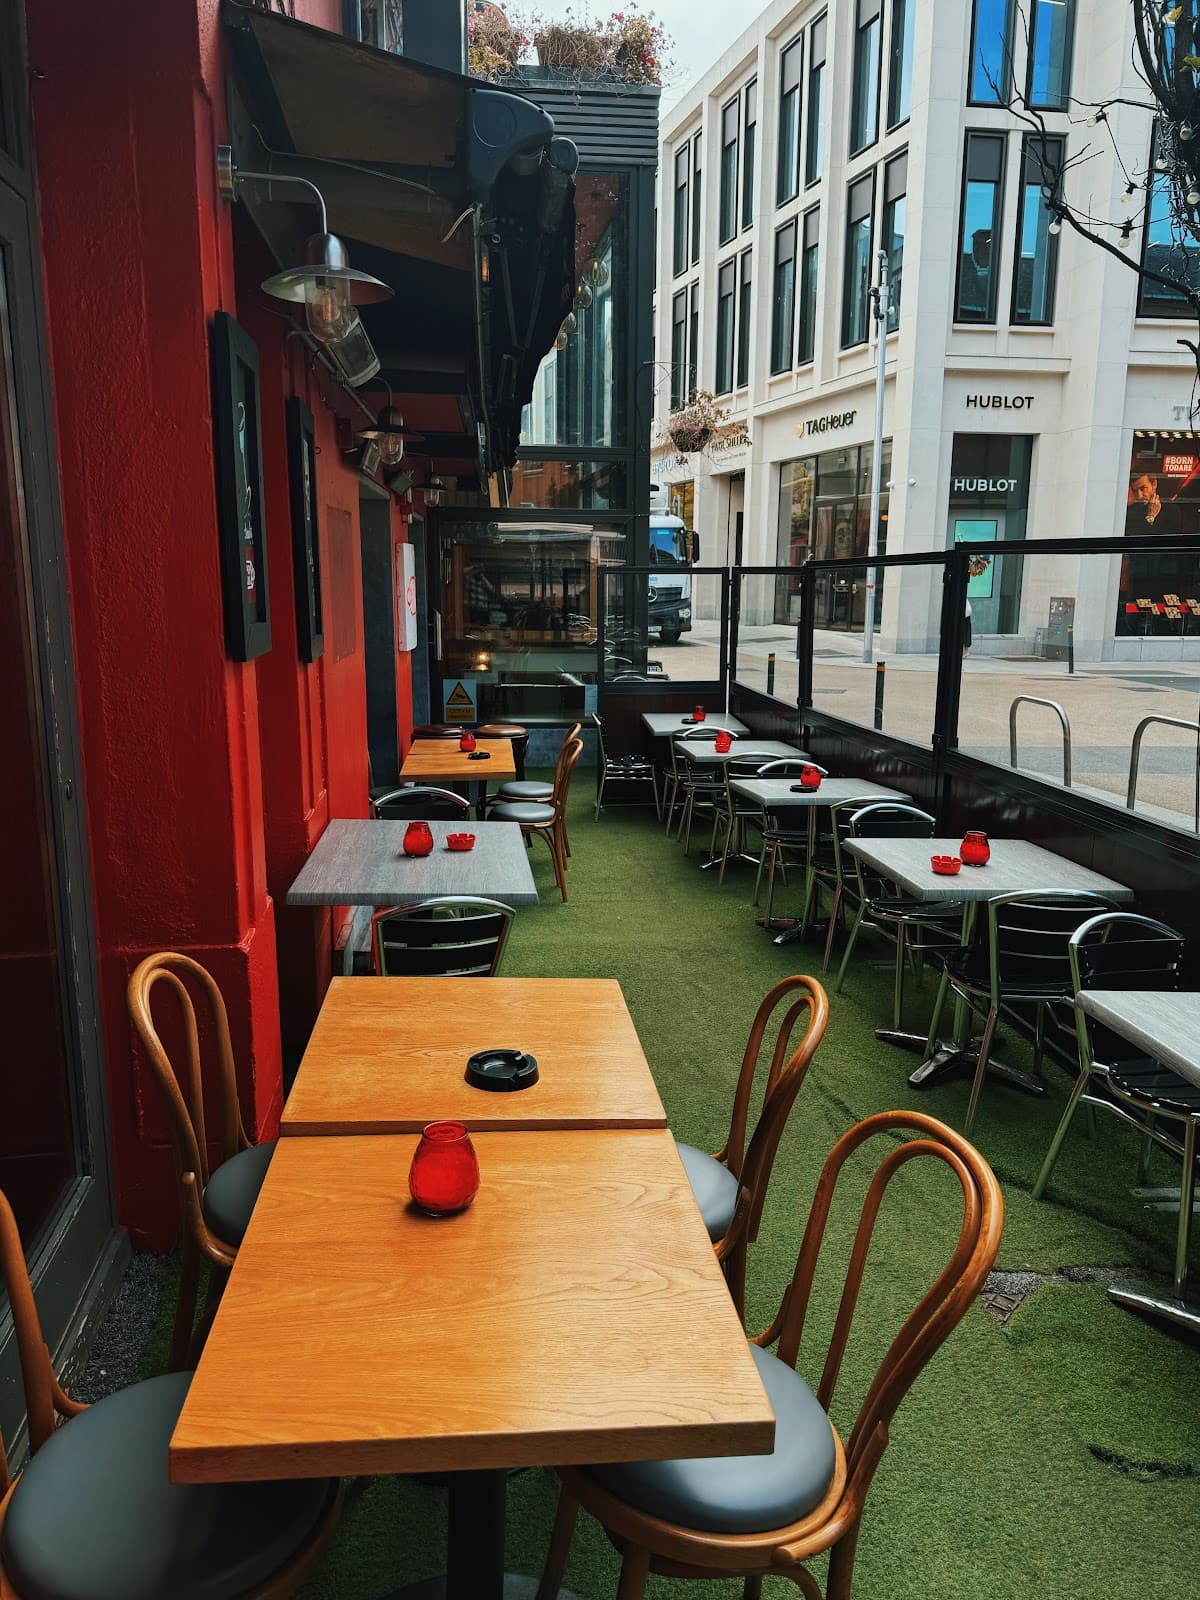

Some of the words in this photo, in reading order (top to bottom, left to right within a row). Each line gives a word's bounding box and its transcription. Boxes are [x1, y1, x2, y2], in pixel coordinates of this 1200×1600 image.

[966, 394, 1035, 409] HUBLOT
[1165, 455, 1194, 465] #BORN
[953, 478, 1018, 492] HUBLOT
